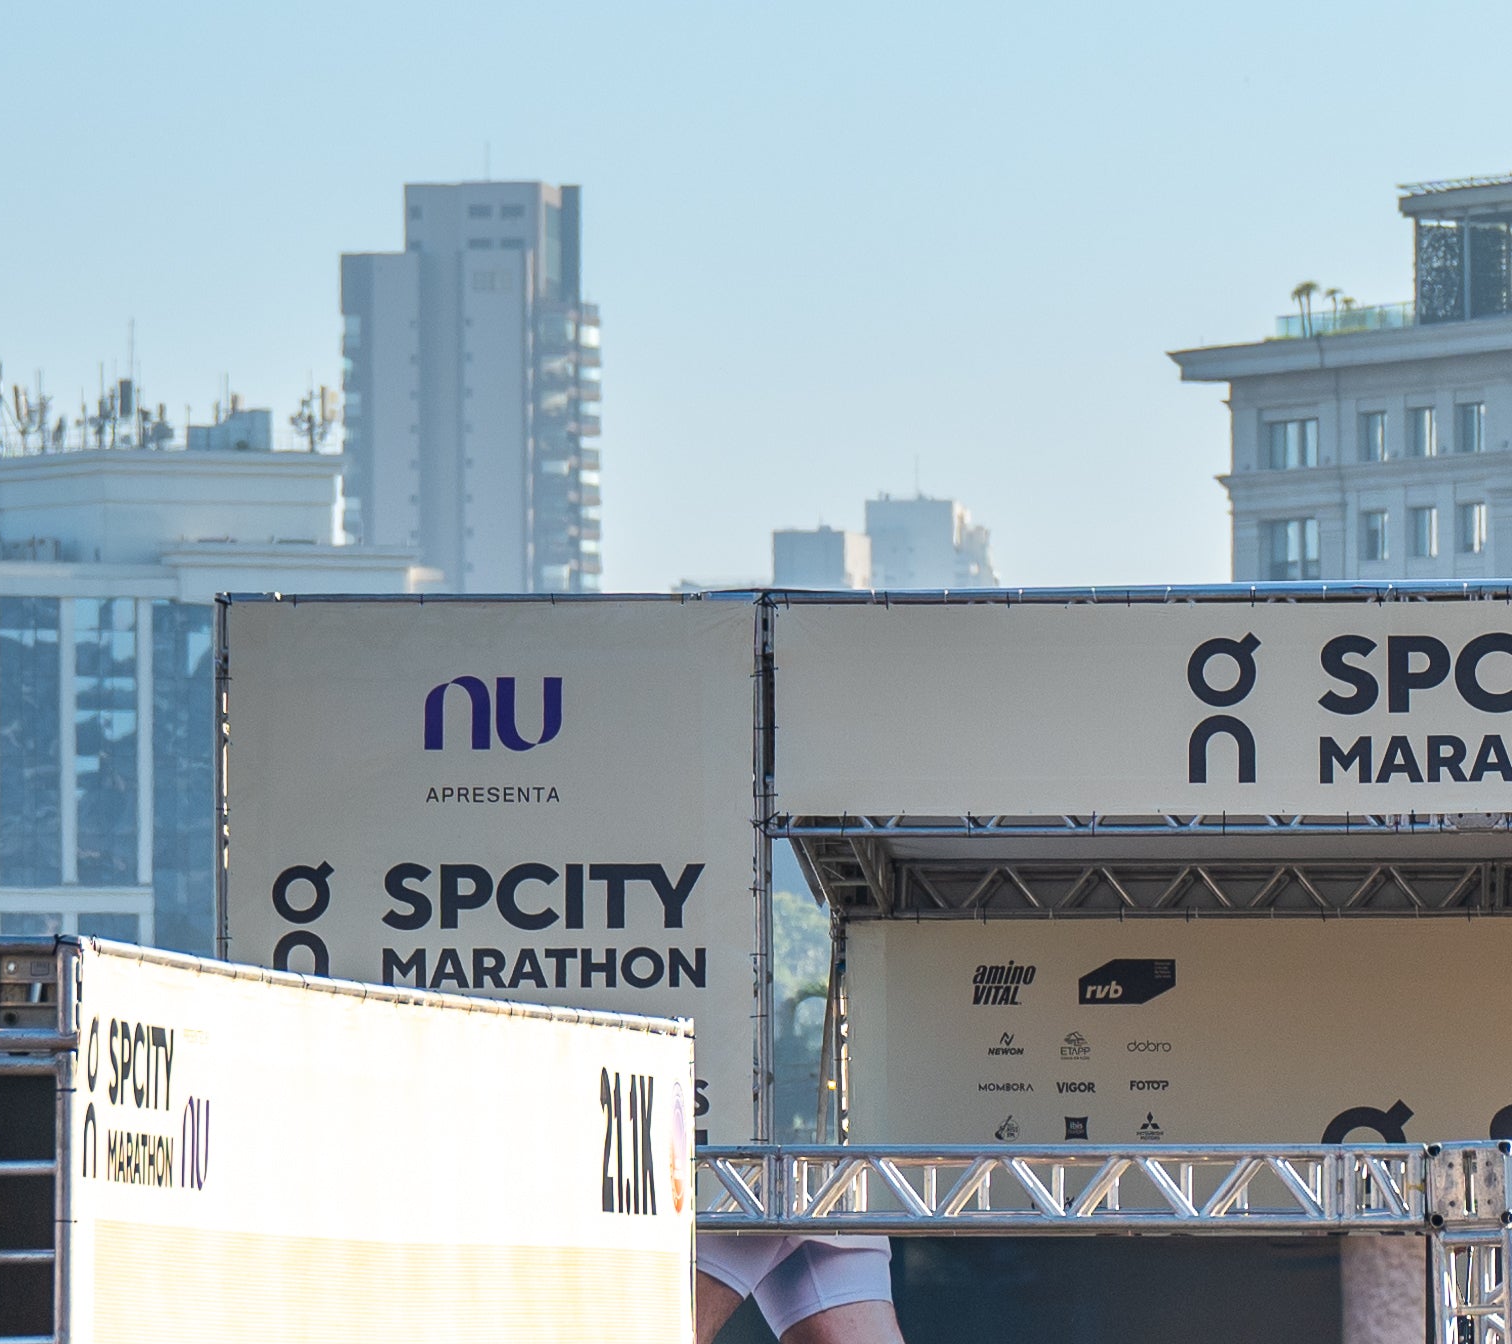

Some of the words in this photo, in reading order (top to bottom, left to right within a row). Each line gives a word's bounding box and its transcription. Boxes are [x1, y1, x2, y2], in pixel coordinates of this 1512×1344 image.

[425, 786, 560, 804] APRESENTA
[381, 862, 706, 931] SPCITY
[381, 946, 707, 989] MARATHON
[972, 959, 1037, 985] amino
[972, 985, 1020, 1006] VITAL
[1085, 980, 1123, 999] rvb
[987, 1047, 1025, 1056] NEWON
[1059, 1046, 1091, 1056] ETAPP
[1126, 1039, 1172, 1053] dobro
[108, 1017, 175, 1112] SPCITY
[1055, 1081, 1096, 1094] VIGOR
[599, 1066, 657, 1216] 21.1K
[107, 1129, 174, 1187] MARATHON
